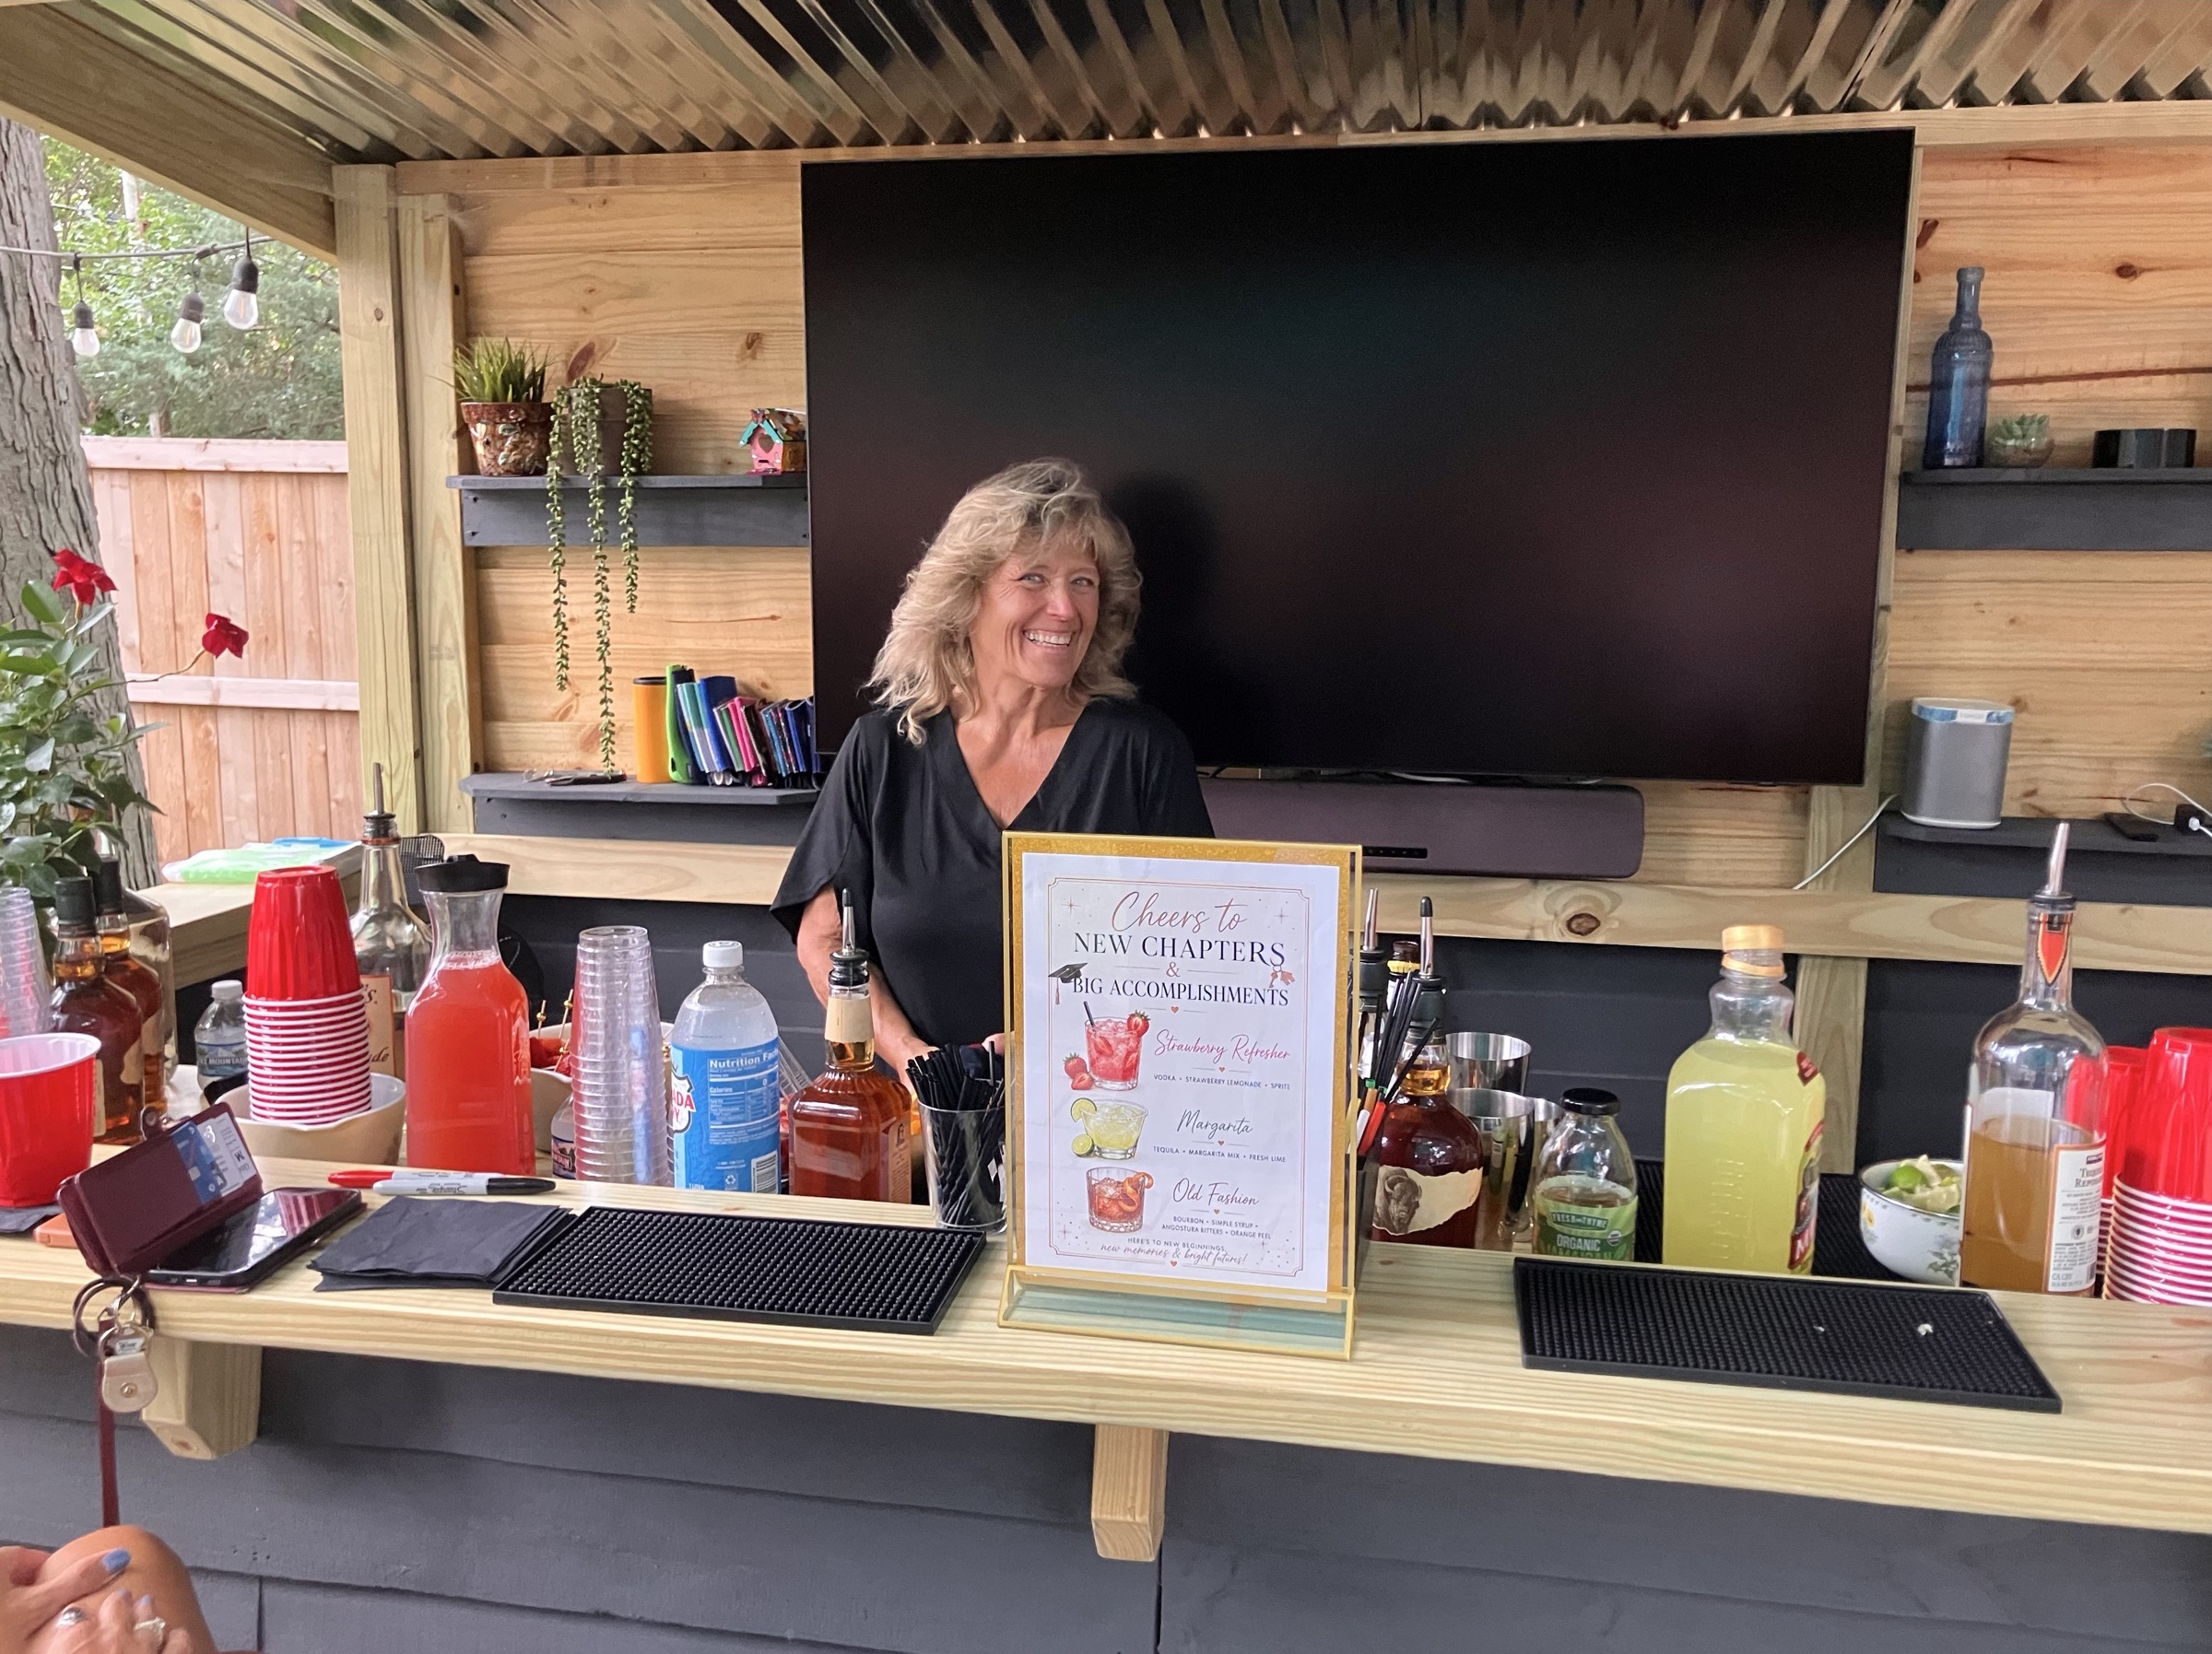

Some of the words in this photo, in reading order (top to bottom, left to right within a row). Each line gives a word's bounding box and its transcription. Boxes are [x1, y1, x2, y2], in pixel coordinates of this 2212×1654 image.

[1112, 891, 1210, 933] Cheers
[1214, 897, 1249, 933] to
[1074, 932, 1133, 955] NEW
[1142, 935, 1285, 967] CHAPTERS
[1166, 961, 1181, 978] &
[1073, 977, 1103, 994] BIG
[1110, 979, 1288, 1006] ACCOMPLISHMENTS
[1154, 1028, 1228, 1064] Strawberry
[1231, 1034, 1291, 1064] Refresher
[709, 1056, 761, 1069] Nutrition
[762, 1078, 769, 1086] 0
[1185, 1075, 1225, 1085] STRAWBERRY
[1227, 1078, 1262, 1088] LEMONADE
[1176, 1109, 1253, 1140] Margarita
[1153, 1145, 1180, 1155] TEQUILA
[1188, 1149, 1225, 1158] MARGARITA
[1172, 1178, 1204, 1202] Old
[1207, 1182, 1260, 1206] Fashion
[1173, 1215, 1205, 1225] BOURBON
[1211, 1219, 1232, 1227] SIMPLE
[1161, 1224, 1199, 1233] ANGOSTURA
[1200, 1226, 1224, 1236] BITTERS
[1230, 1229, 1256, 1238] ORANGE
[1257, 1232, 1272, 1240] PEEL
[1556, 1234, 1602, 1252] ORGANIC
[1100, 1244, 1121, 1252] new
[1124, 1246, 1170, 1259] memories
[1171, 1248, 1182, 1259] &
[1183, 1248, 1214, 1266] bright
[1211, 1251, 1249, 1266] futures!
